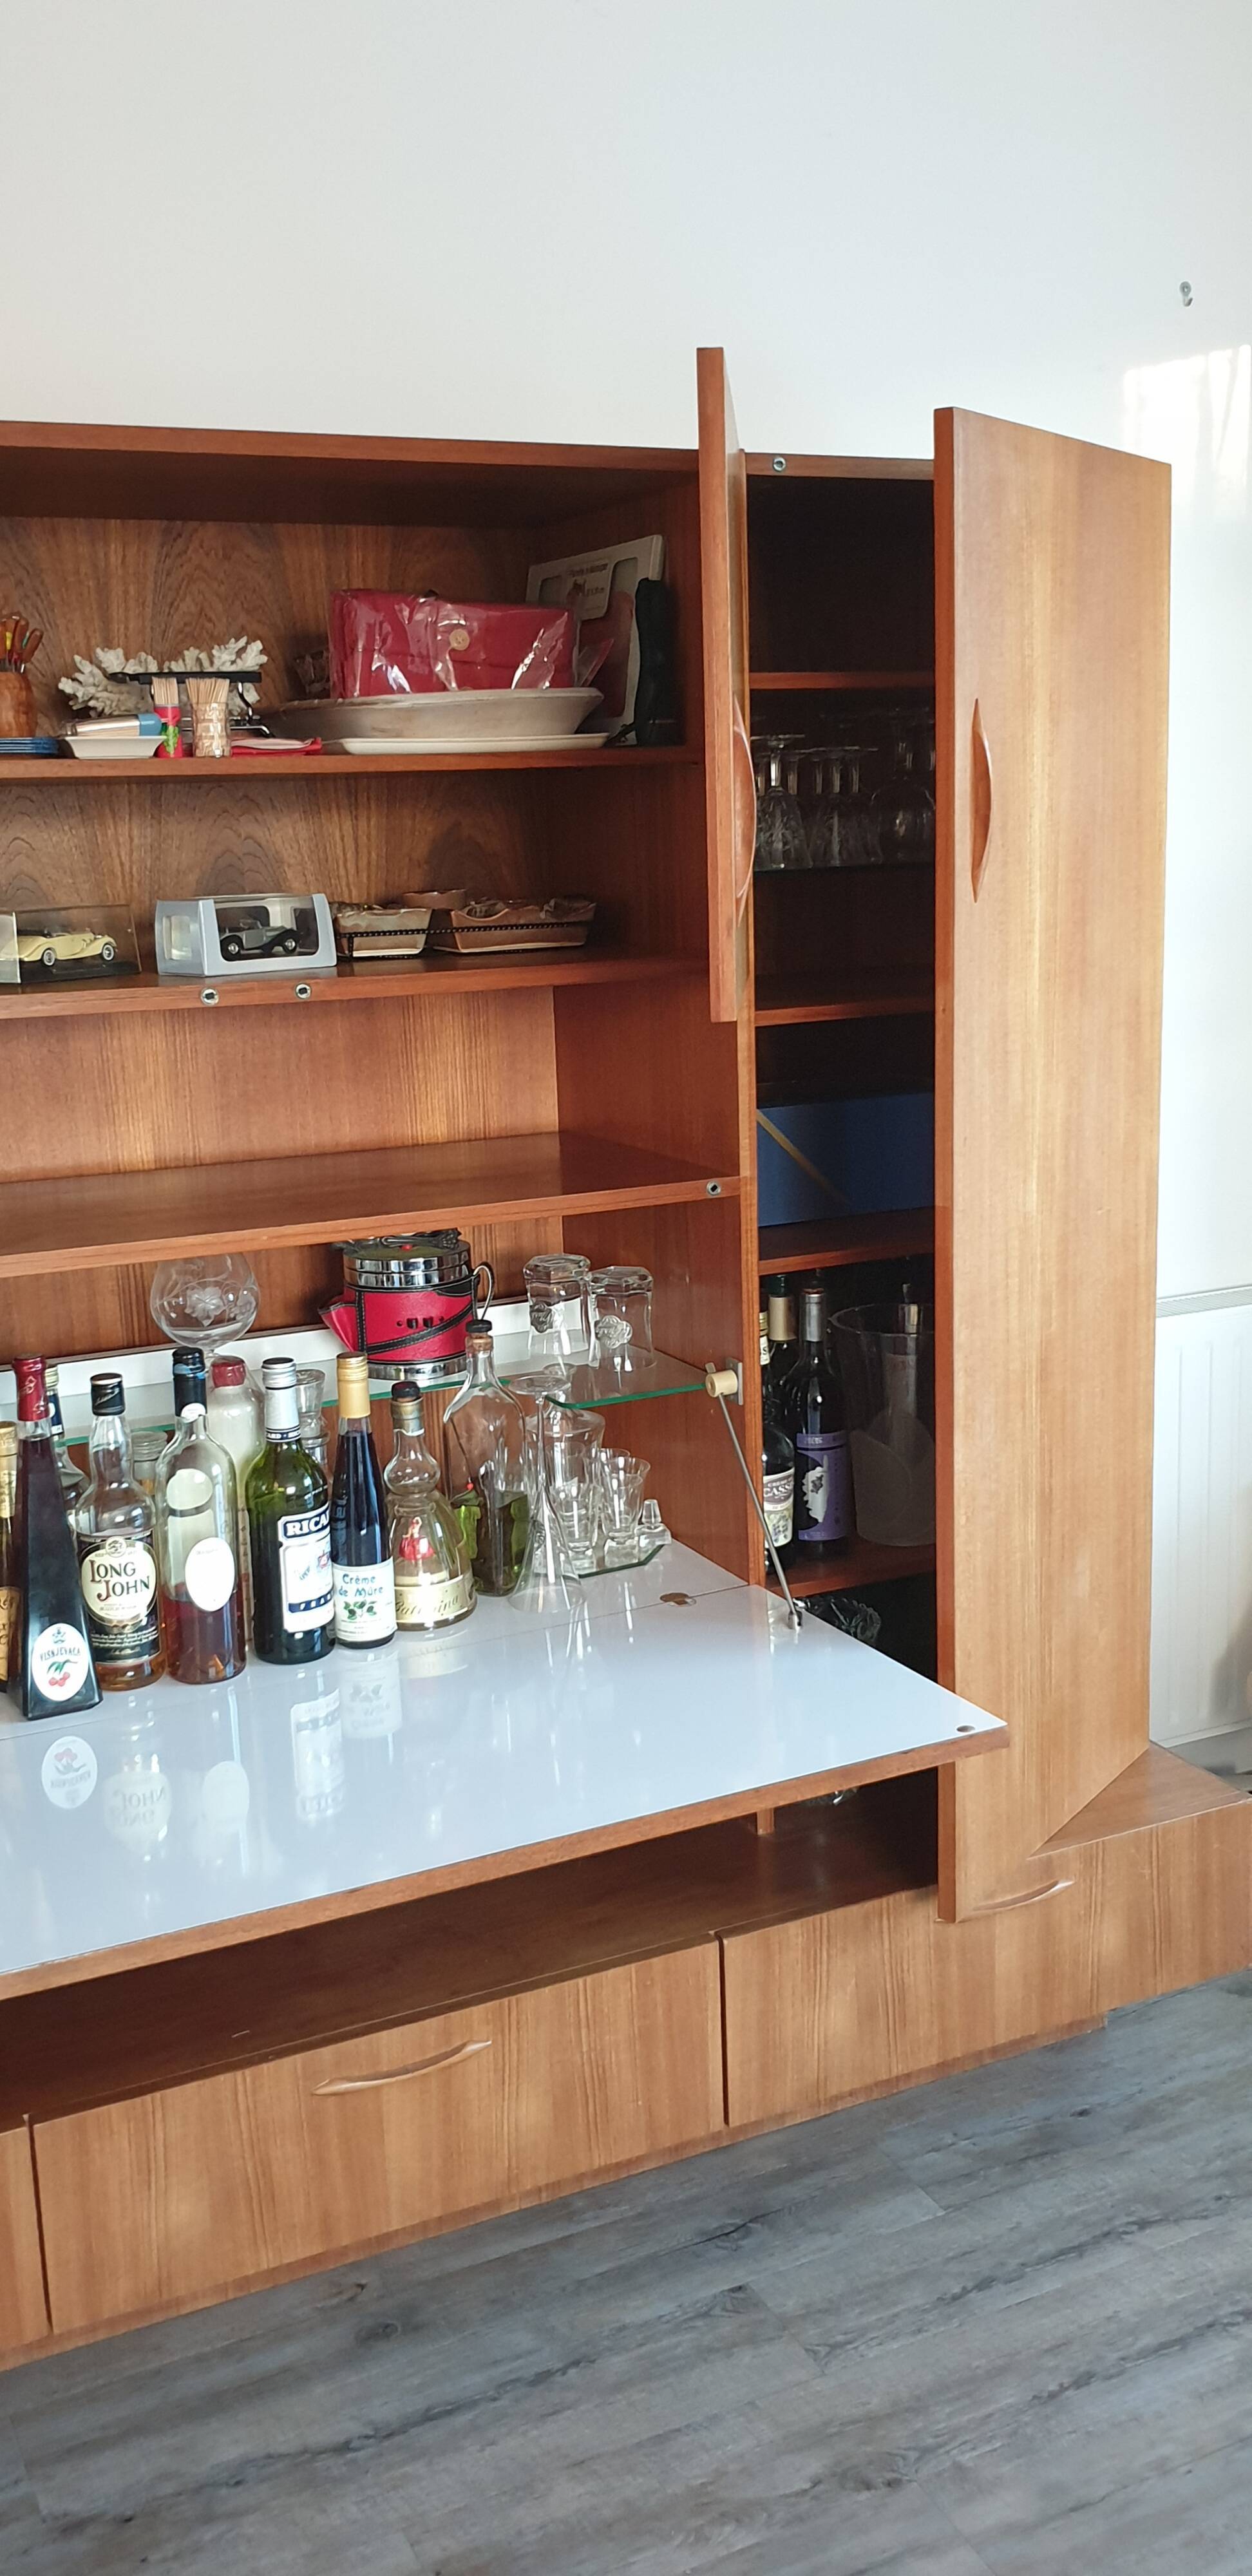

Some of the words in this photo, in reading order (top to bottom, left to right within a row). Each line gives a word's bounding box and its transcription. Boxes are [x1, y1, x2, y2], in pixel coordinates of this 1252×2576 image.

[286, 1510, 330, 1537] RICA
[89, 1558, 137, 1583] LONG
[342, 1573, 376, 1585] Crème
[97, 1576, 150, 1602] JOHN
[338, 1586, 348, 1596] de
[354, 1586, 384, 1598] Mûre
